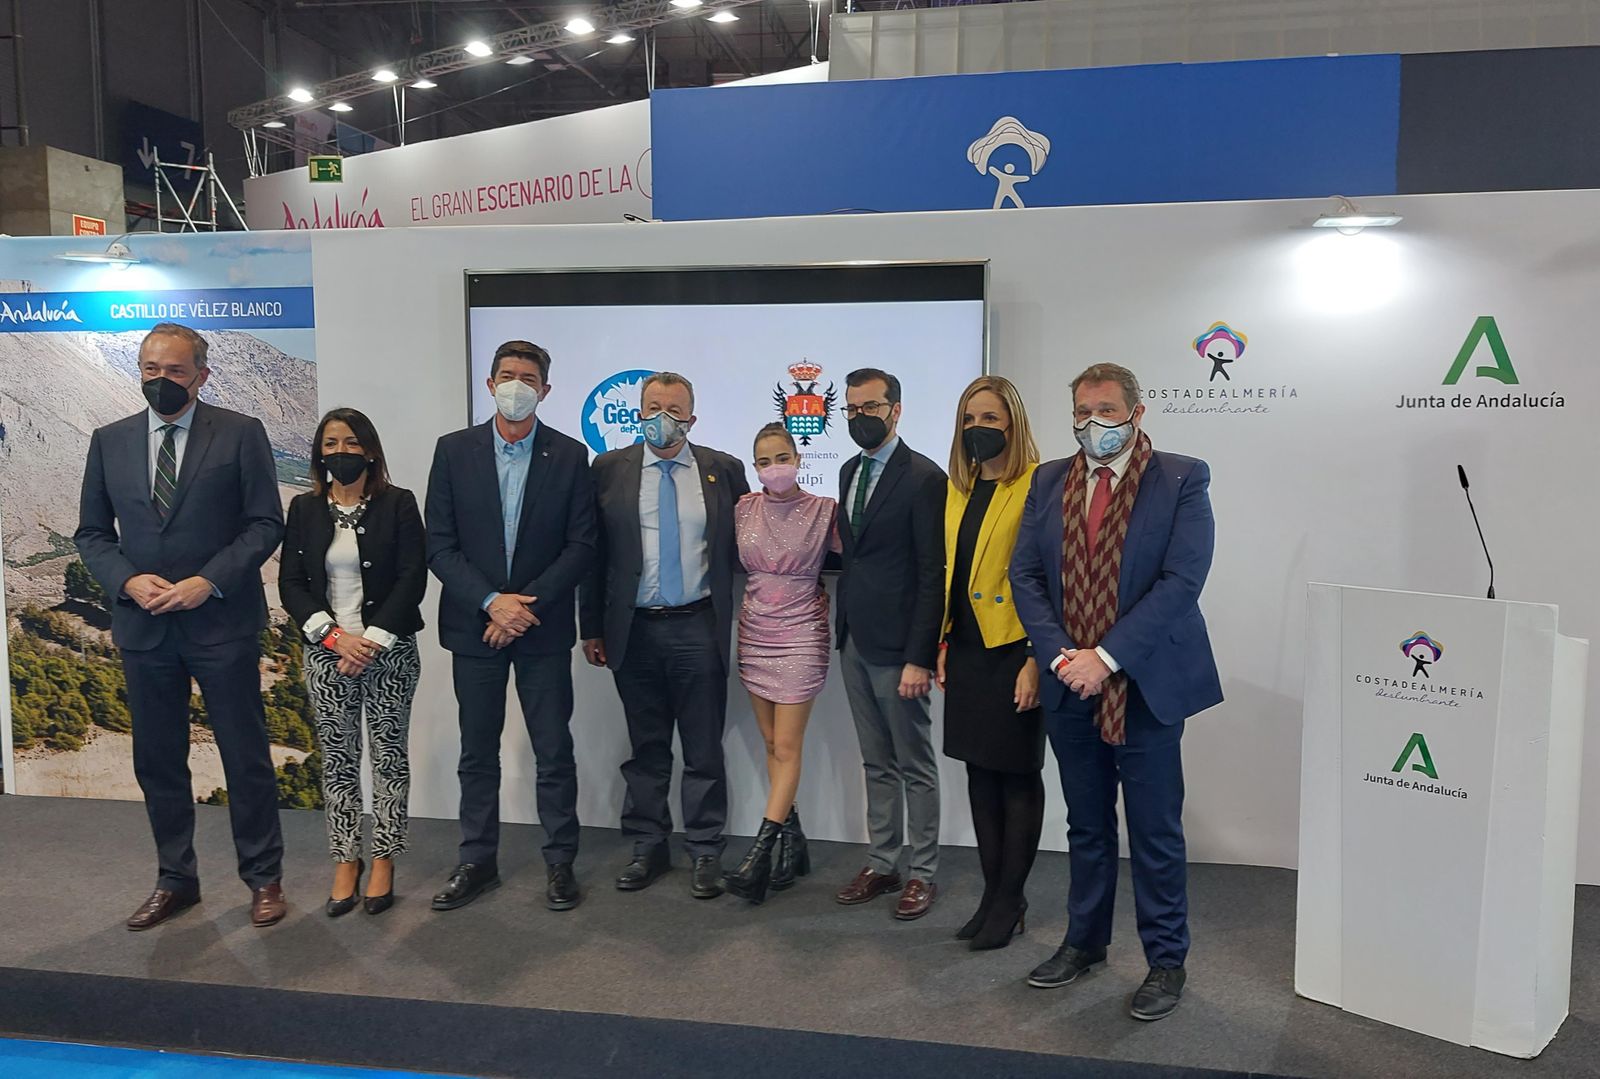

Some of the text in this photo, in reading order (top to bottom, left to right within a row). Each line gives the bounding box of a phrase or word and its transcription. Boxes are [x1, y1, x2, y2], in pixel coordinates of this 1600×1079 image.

[411, 164, 633, 221] EL GRAN ESCENARIO DE LA
[0, 300, 83, 324] Andalucía
[110, 299, 282, 320] CASTILLO DE VÉLEZ BLANCO
[616, 399, 627, 407] La
[1162, 402, 1270, 414] deslumbrante
[1395, 391, 1565, 408] Junta de Andalucía
[603, 403, 641, 424] Geo
[797, 473, 823, 486] ulpí
[1356, 674, 1484, 699] COSTADEALMERÍA
[1375, 688, 1461, 708] deslumbrante
[1363, 772, 1468, 799] Junta de Andalucía
